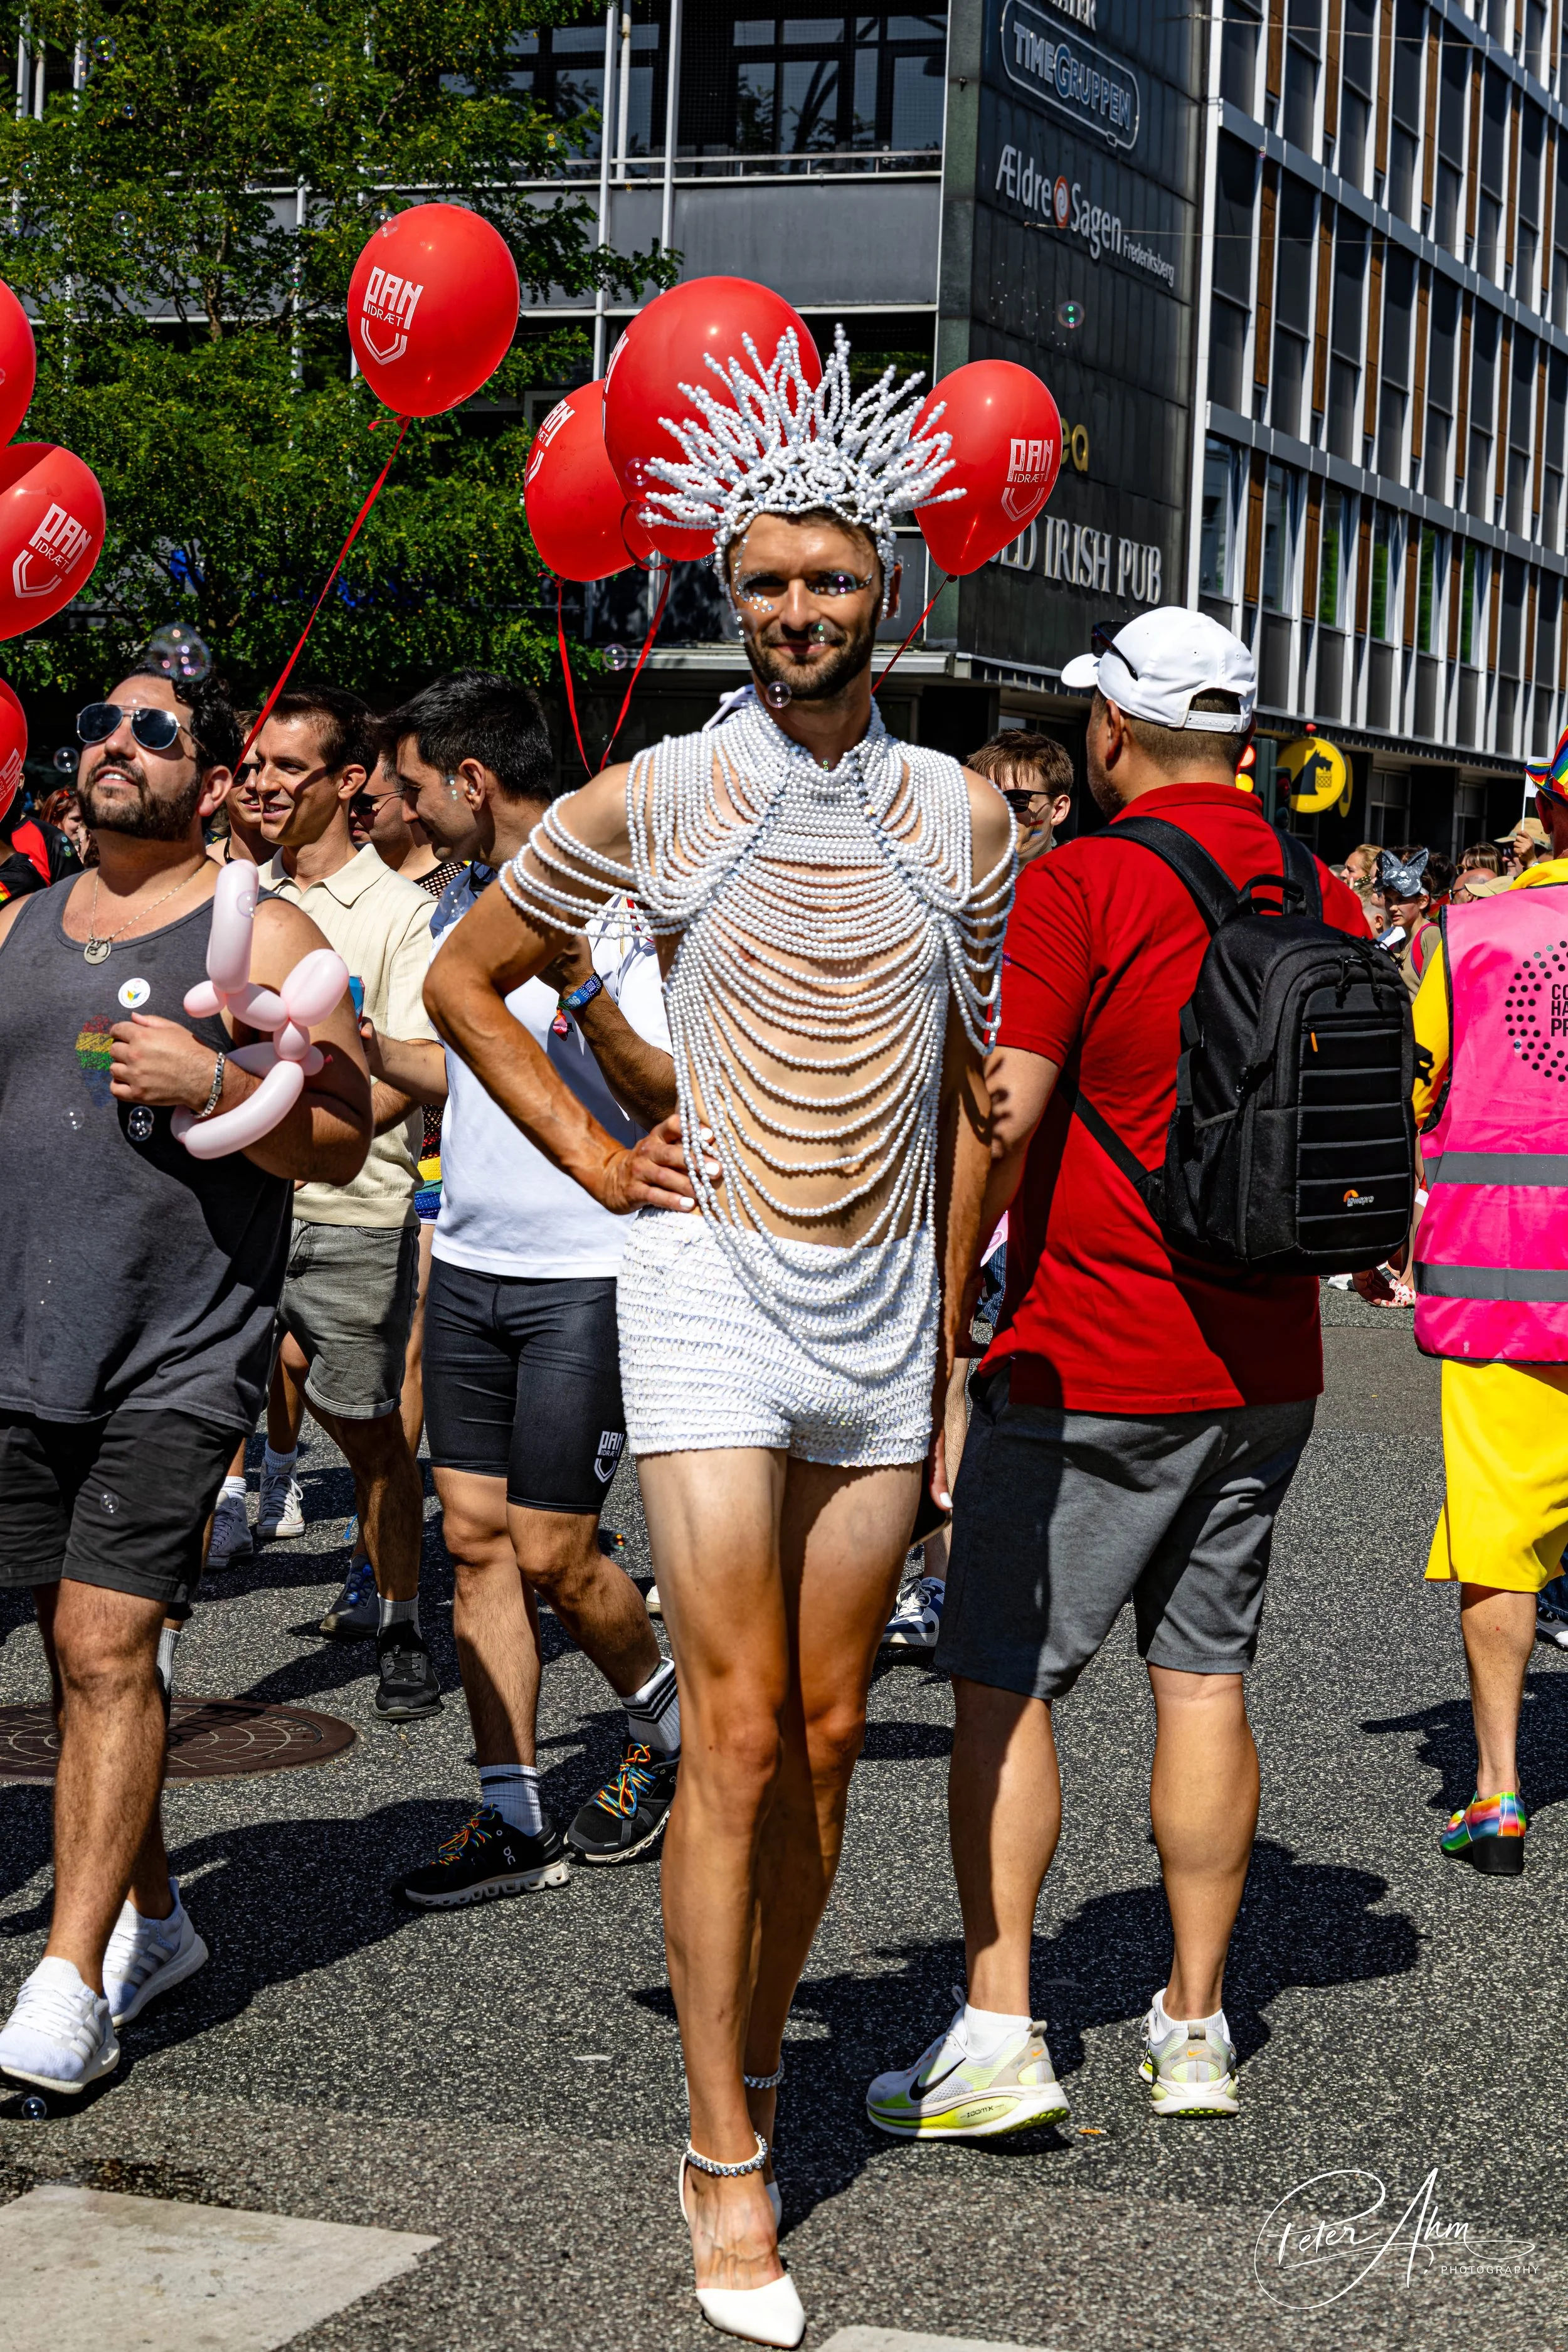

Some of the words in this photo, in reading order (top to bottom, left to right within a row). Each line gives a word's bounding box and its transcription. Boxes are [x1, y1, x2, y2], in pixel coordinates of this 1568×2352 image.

[995, 144, 1052, 217] Ældre
[1071, 183, 1121, 260] Sagen
[1123, 238, 1175, 288] Frederiksberg
[368, 304, 403, 327] IDRÆT
[1014, 473, 1045, 483] IDRÆT
[35, 539, 70, 570] IDRÆT
[1044, 515, 1112, 593] IRISH
[1117, 538, 1162, 605] PUB
